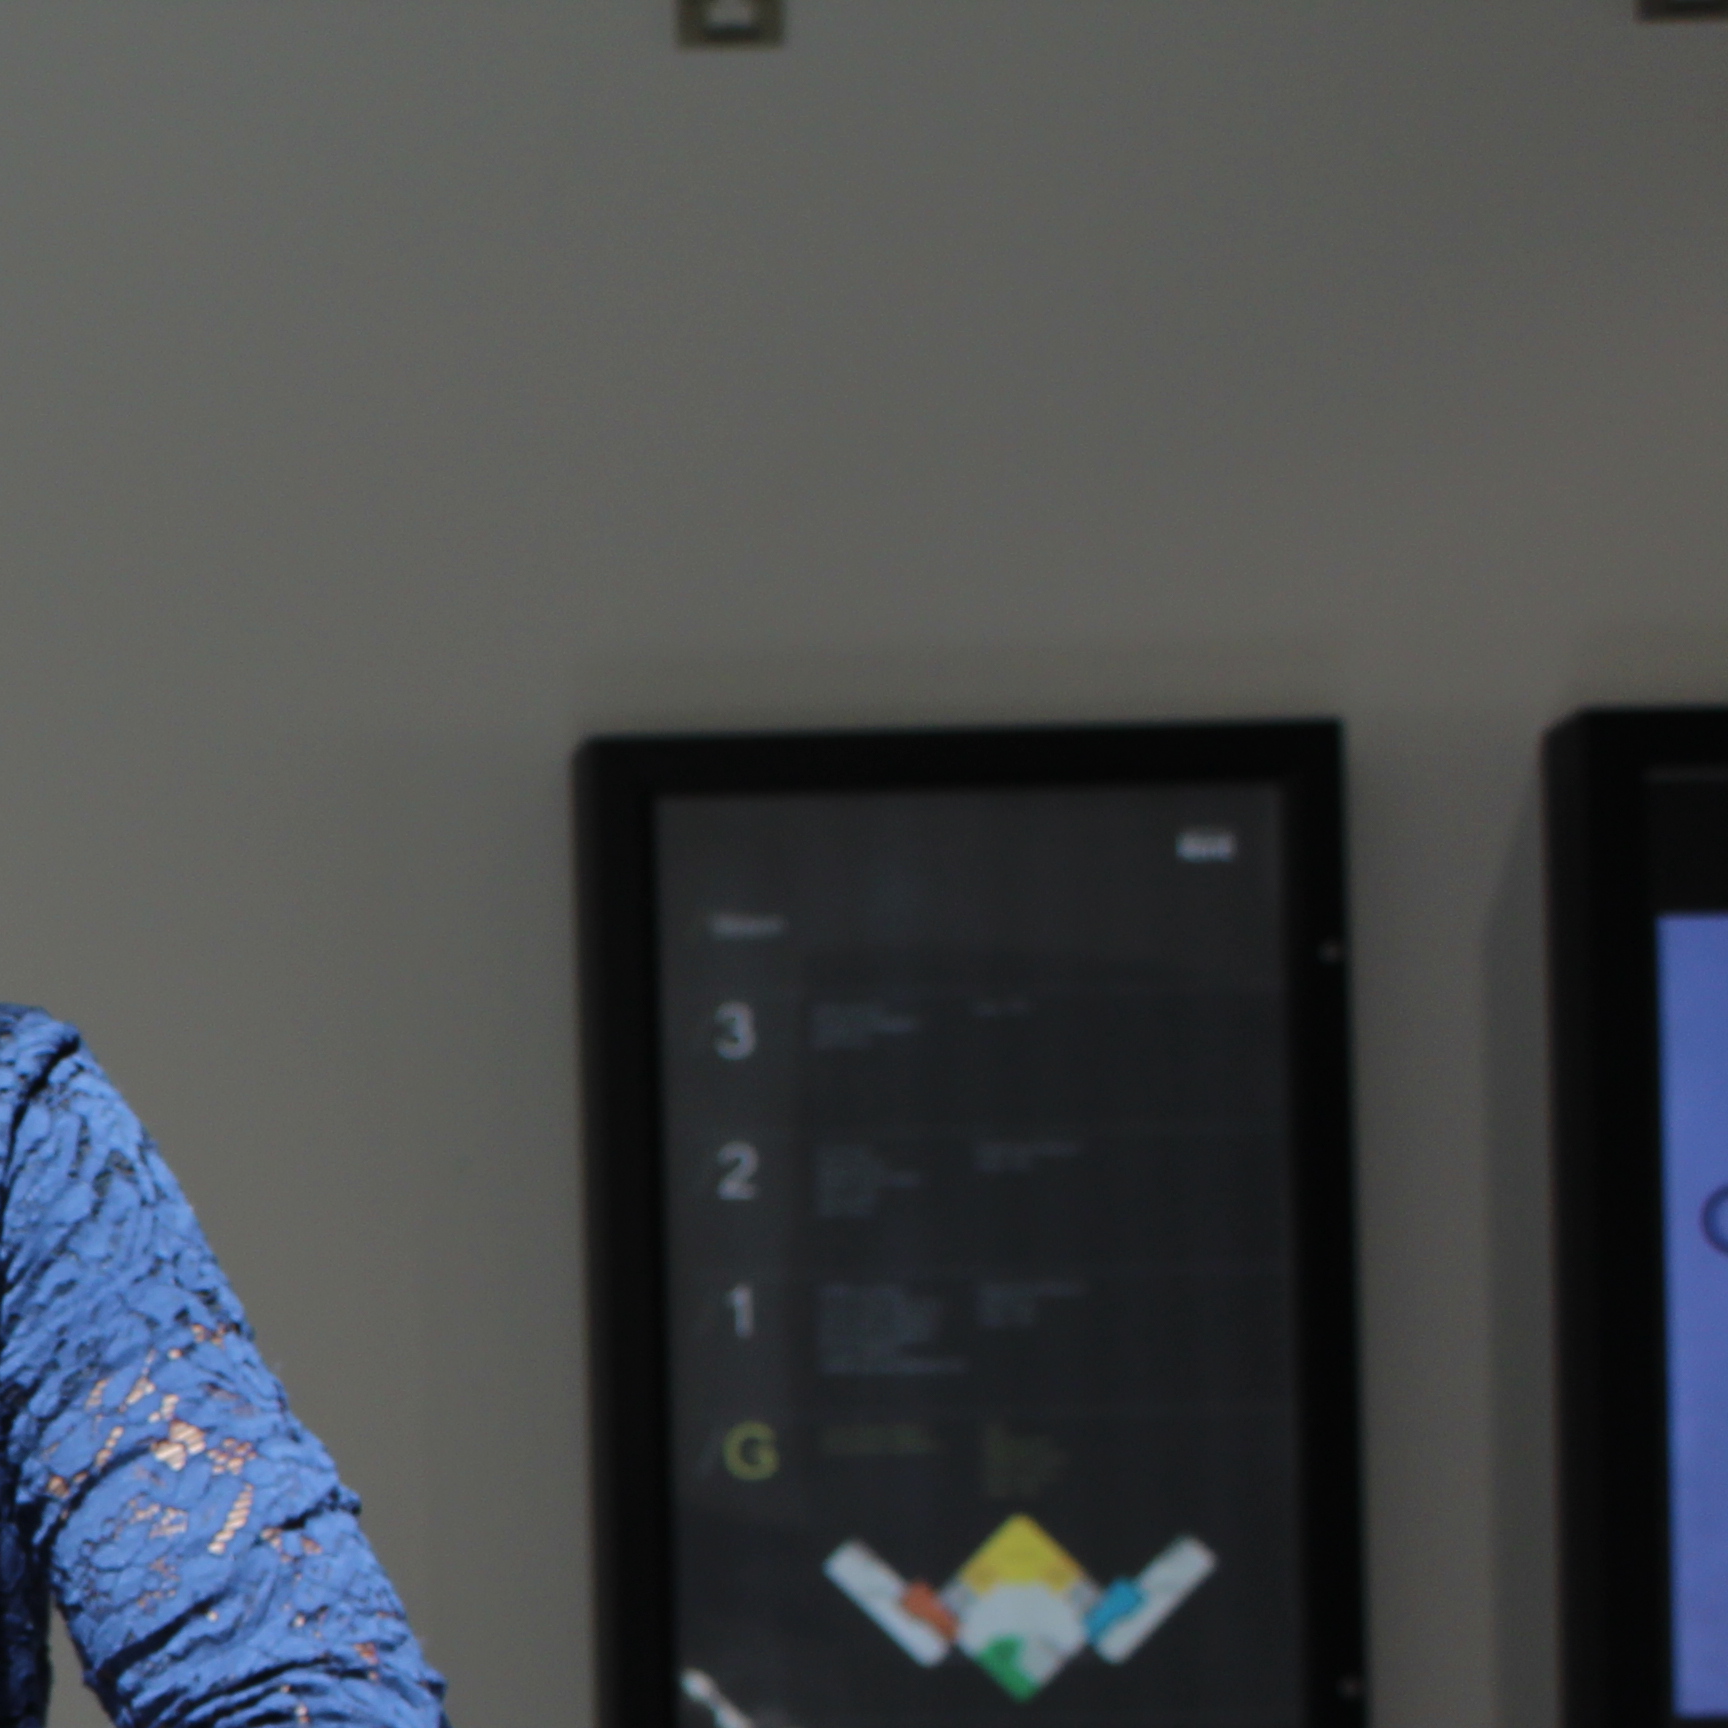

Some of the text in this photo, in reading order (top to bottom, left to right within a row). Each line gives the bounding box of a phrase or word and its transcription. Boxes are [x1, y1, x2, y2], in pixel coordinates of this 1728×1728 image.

[715, 1003, 756, 1060] 3
[718, 1142, 758, 1200] 2
[726, 1286, 754, 1337] 1
[724, 1422, 780, 1480] G
